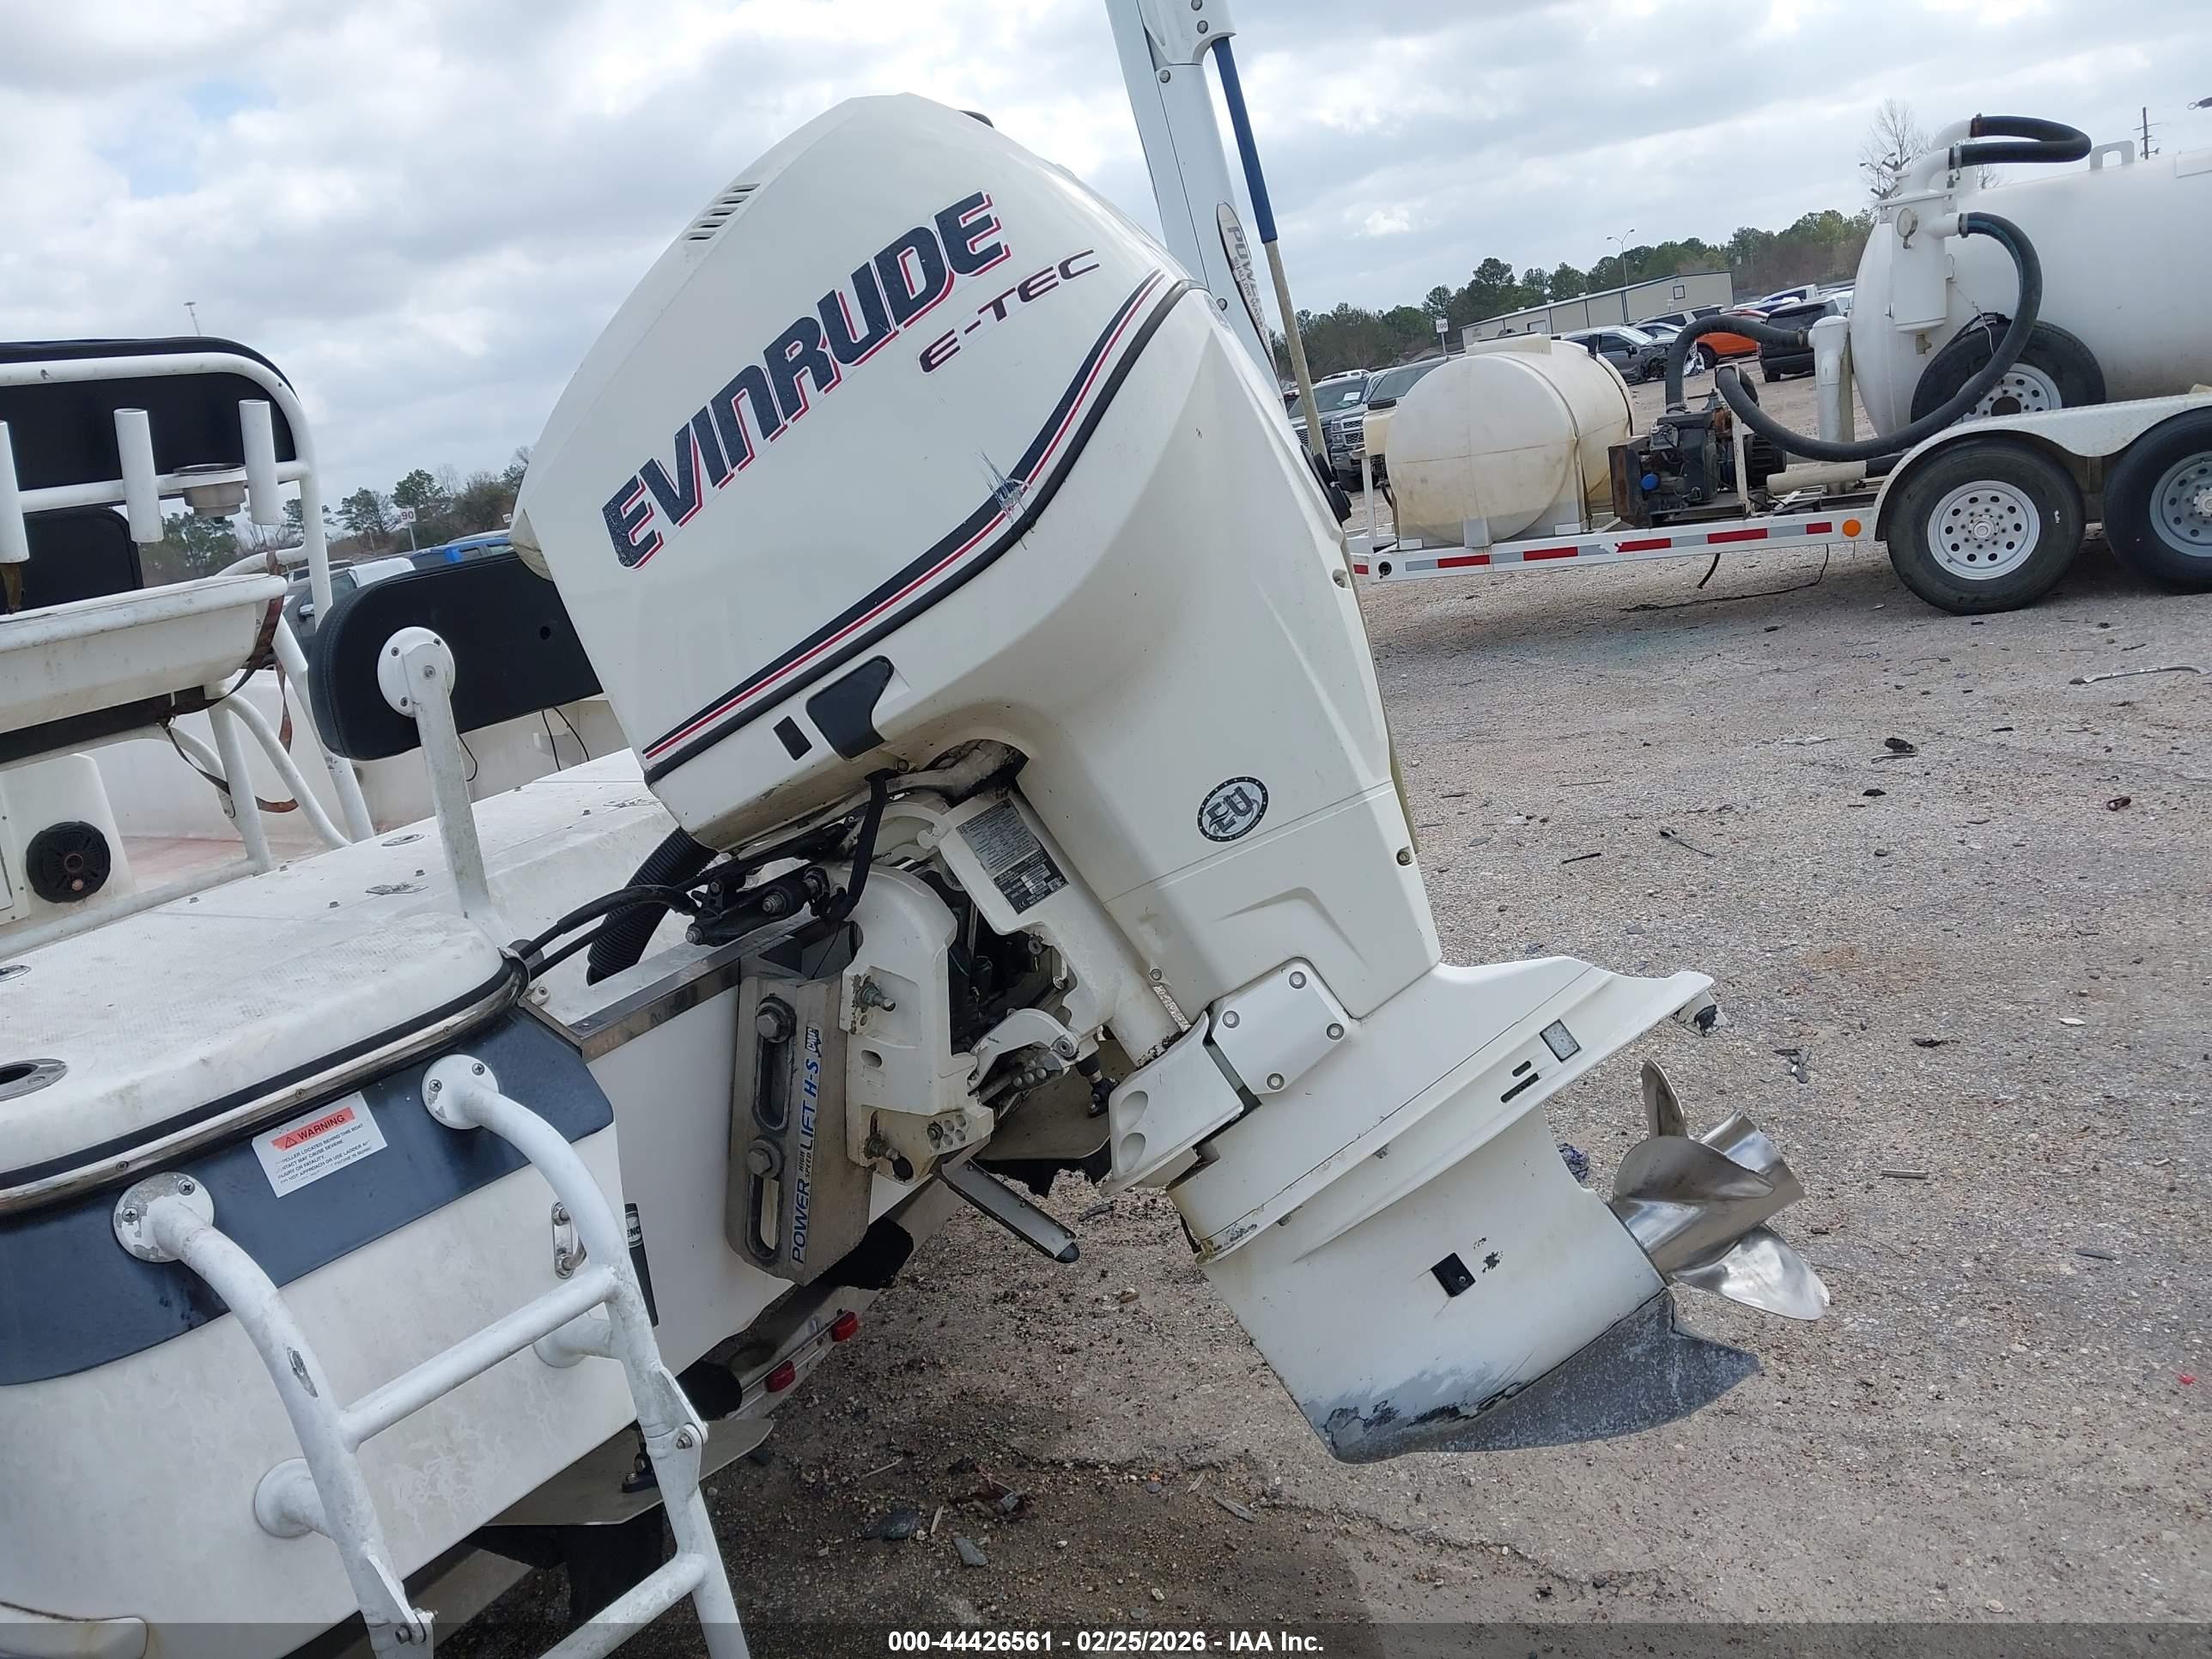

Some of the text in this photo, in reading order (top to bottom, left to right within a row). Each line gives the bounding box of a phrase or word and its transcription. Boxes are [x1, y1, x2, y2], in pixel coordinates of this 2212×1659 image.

[917, 247, 1101, 374] E-TEC
[601, 190, 1011, 569] EVINRUDE
[401, 511, 415, 520] 90
[297, 1115, 345, 1140] WARNING
[792, 1058, 820, 1264] POWER LIFT H-S
[797, 1149, 805, 1170] HIGH
